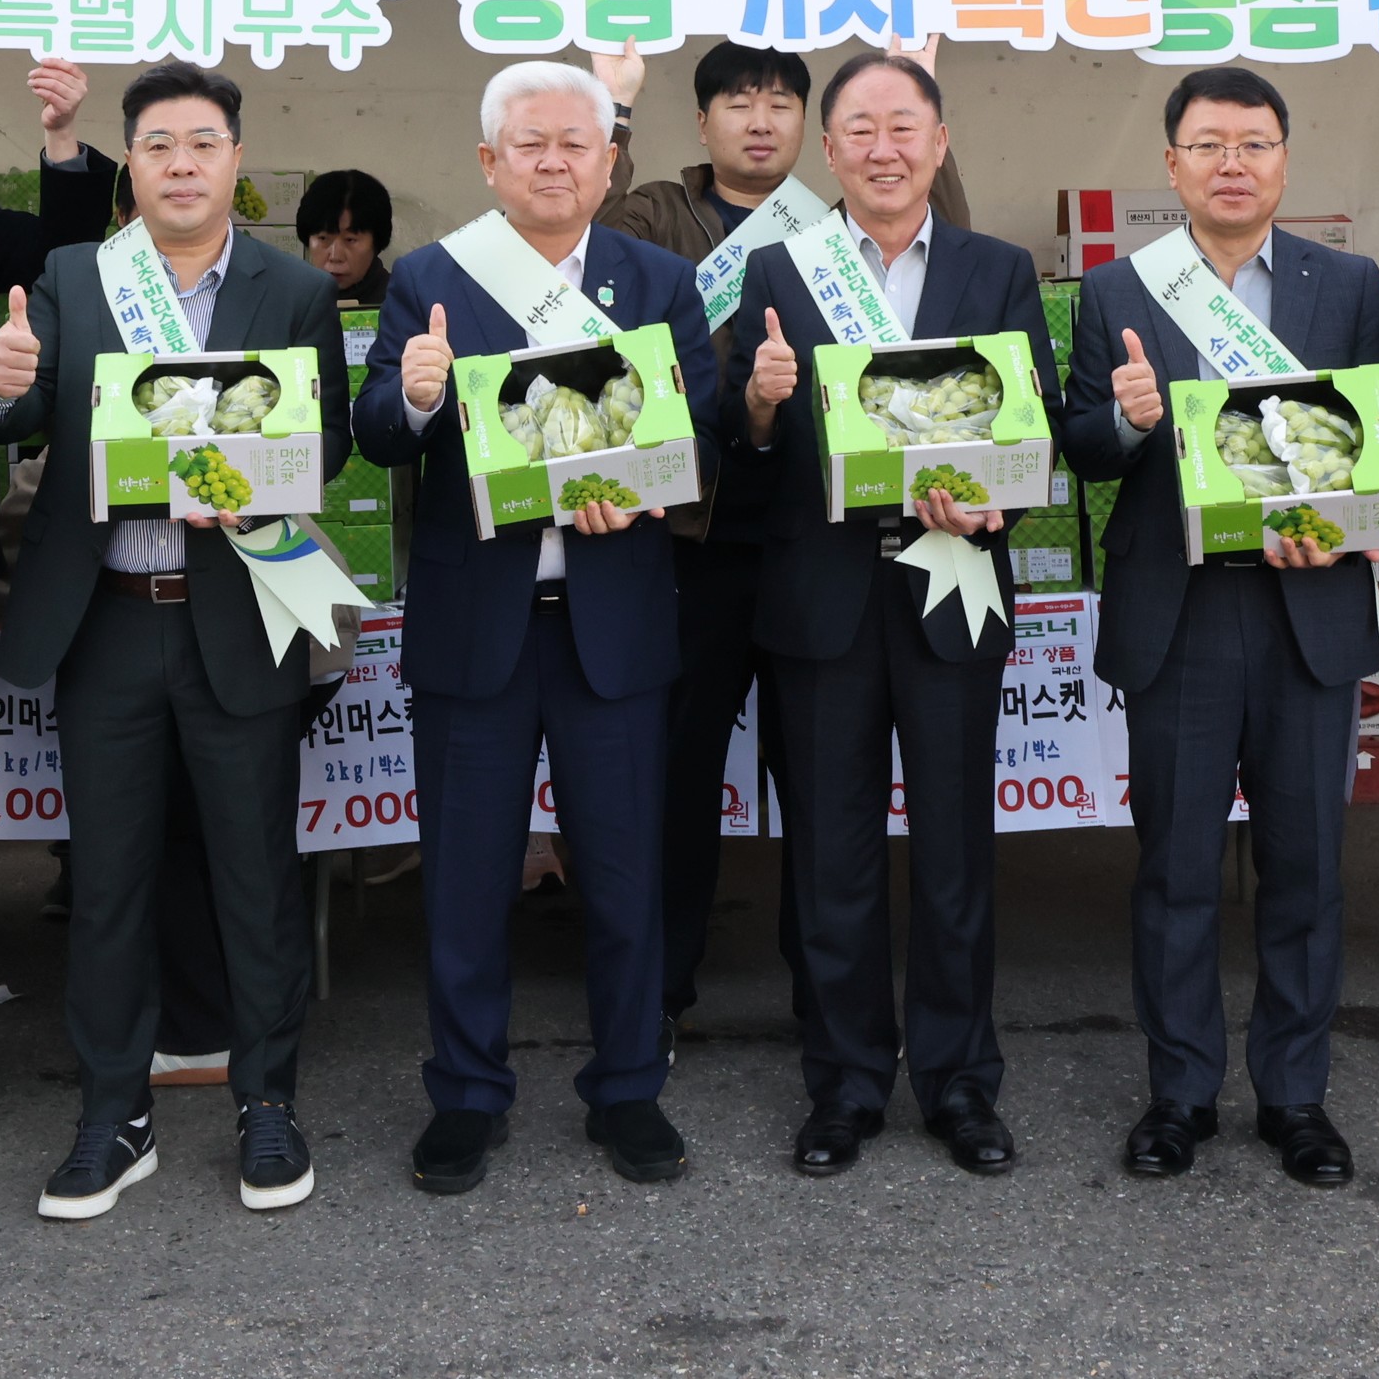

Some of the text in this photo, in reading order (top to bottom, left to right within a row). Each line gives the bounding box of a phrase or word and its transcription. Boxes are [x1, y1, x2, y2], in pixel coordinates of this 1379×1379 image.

[699, 244, 744, 291] 소비촉
[132, 250, 191, 353] 무주반딧불포
[1208, 295, 1294, 375] 무주반딧불
[1043, 647, 1075, 663] 상품
[1003, 679, 1087, 725] 머스켓
[998, 775, 1085, 812] 000
